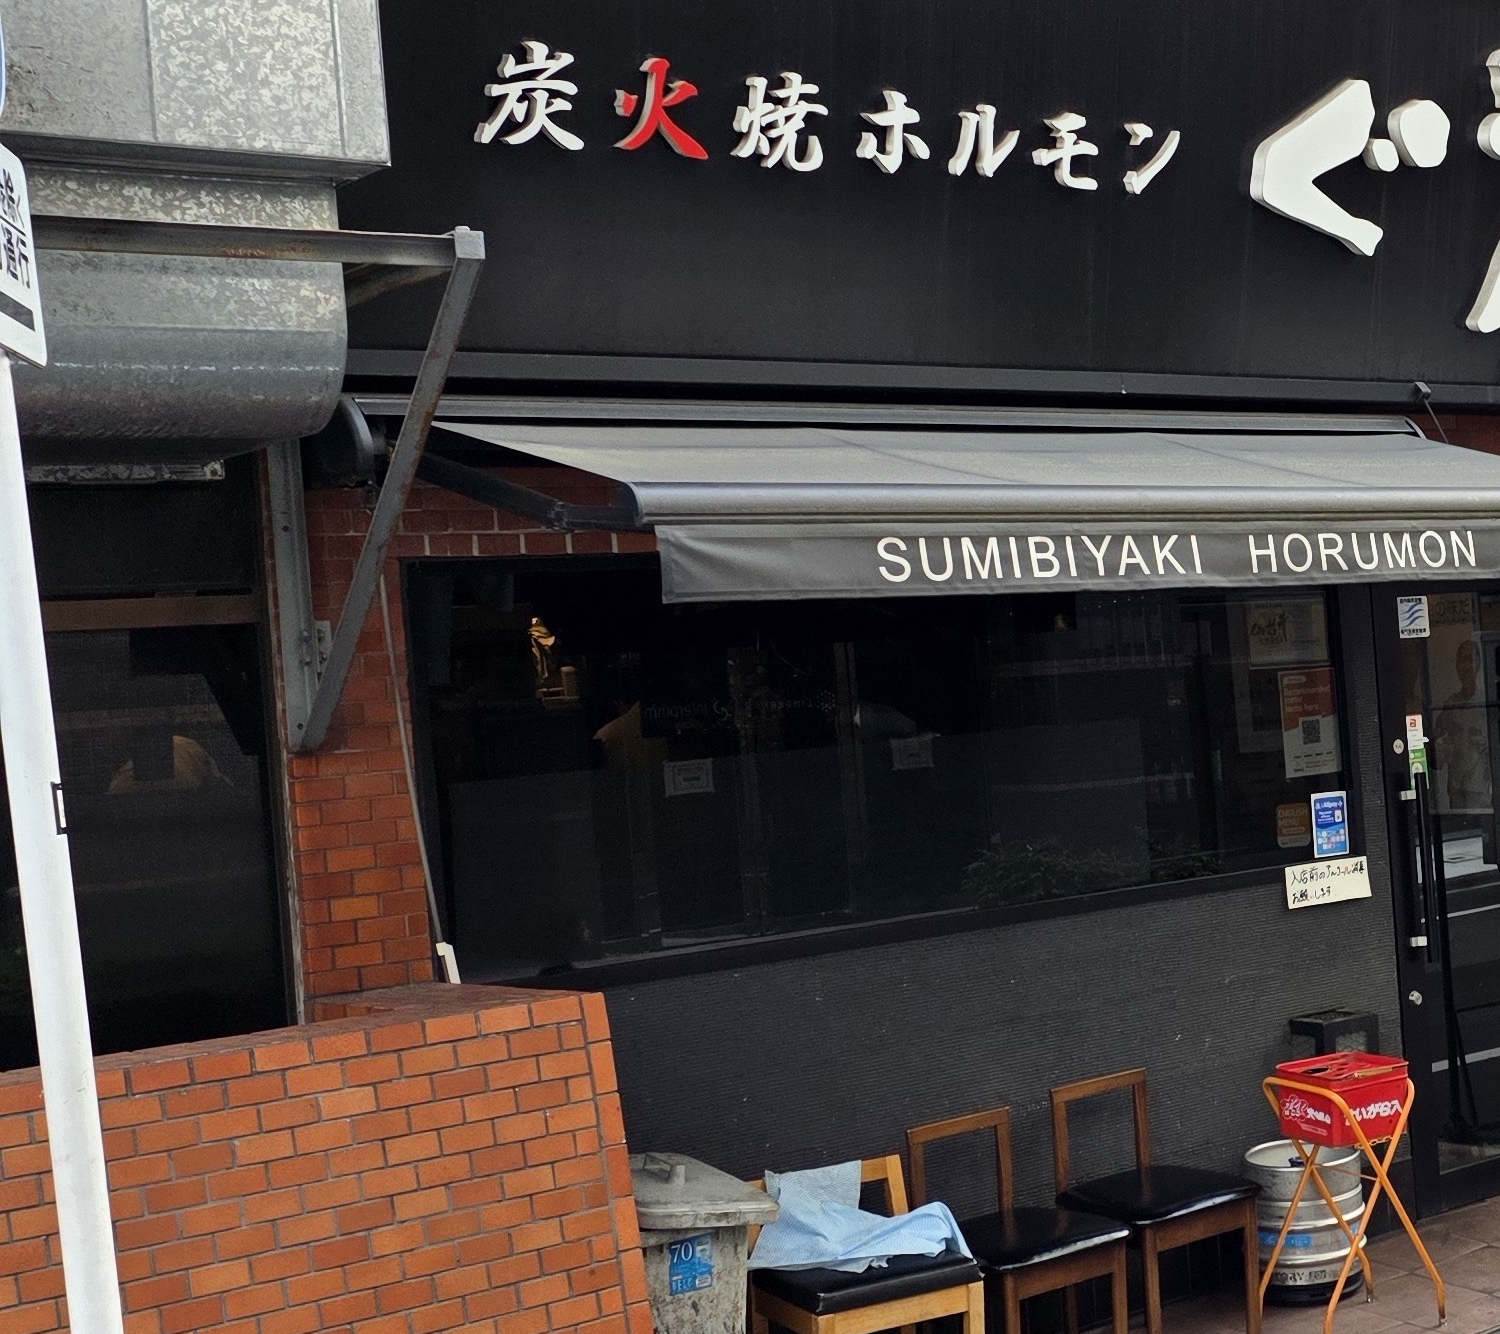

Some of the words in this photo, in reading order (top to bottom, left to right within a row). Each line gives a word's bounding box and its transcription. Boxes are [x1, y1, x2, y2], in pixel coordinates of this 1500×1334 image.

[474, 38, 1182, 195] 炭火焼ホルモン
[876, 534, 1203, 583] SUMIBIYAKI
[1248, 530, 1477, 574] HORUMON
[670, 1241, 693, 1264] 70
